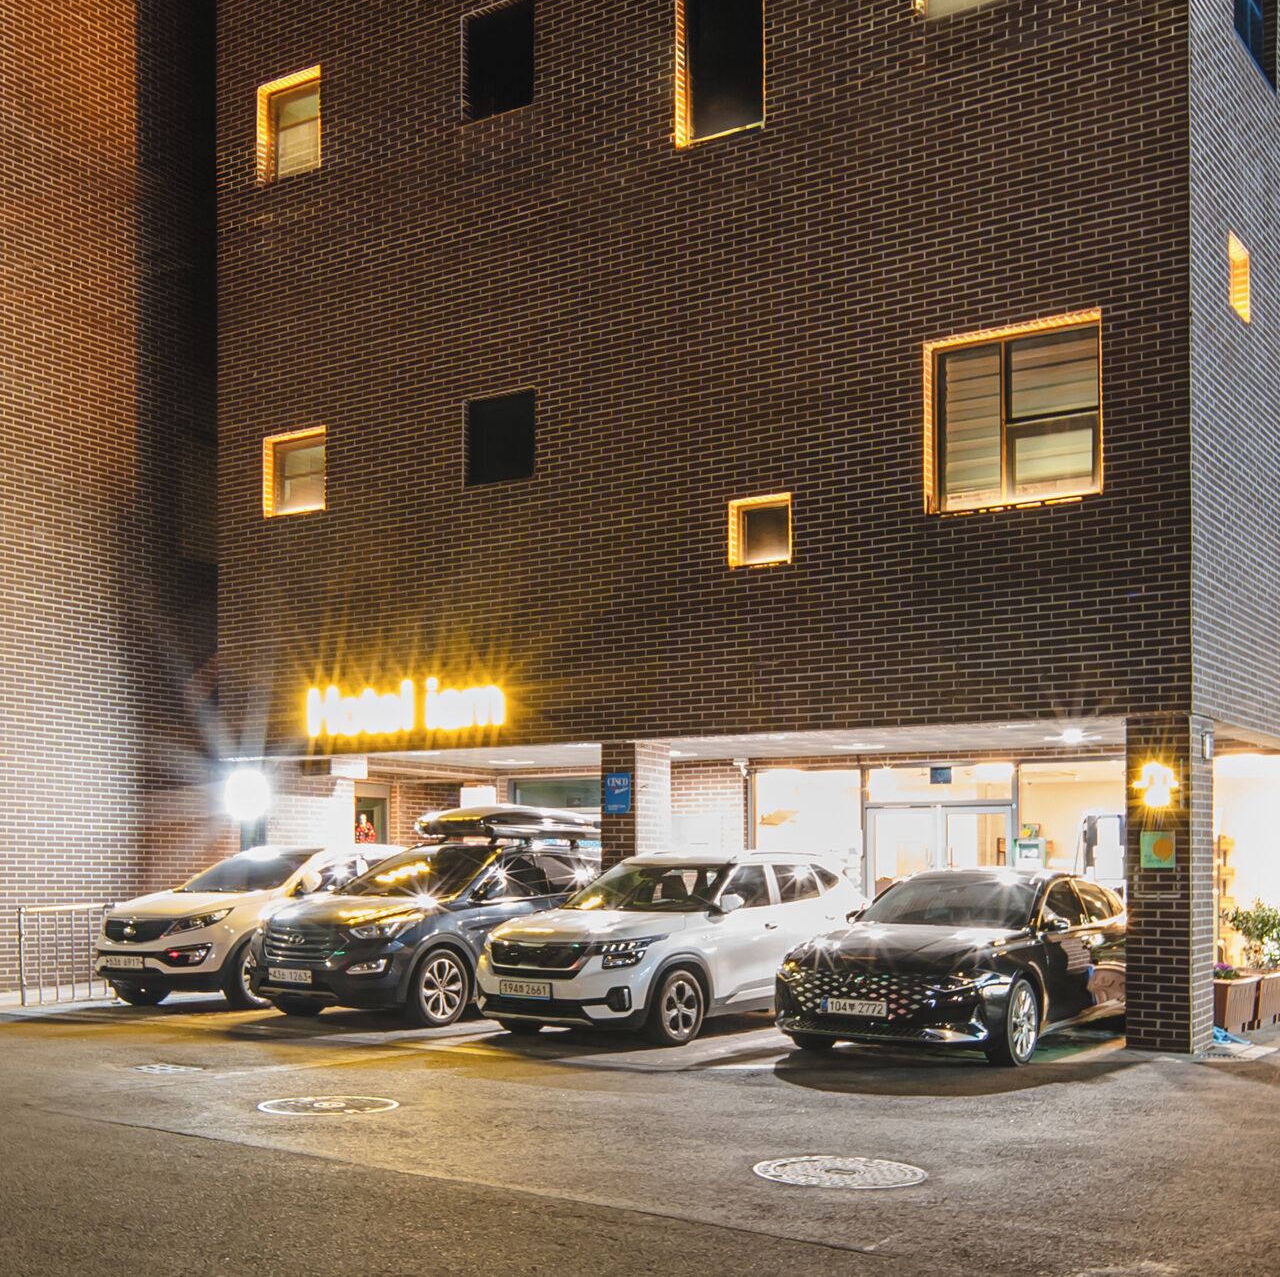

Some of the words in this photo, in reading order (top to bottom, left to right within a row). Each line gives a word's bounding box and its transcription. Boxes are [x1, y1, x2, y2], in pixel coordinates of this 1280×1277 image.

[307, 679, 414, 737] Hotel
[526, 984, 546, 995] 2661
[858, 1002, 884, 1015] 2772
